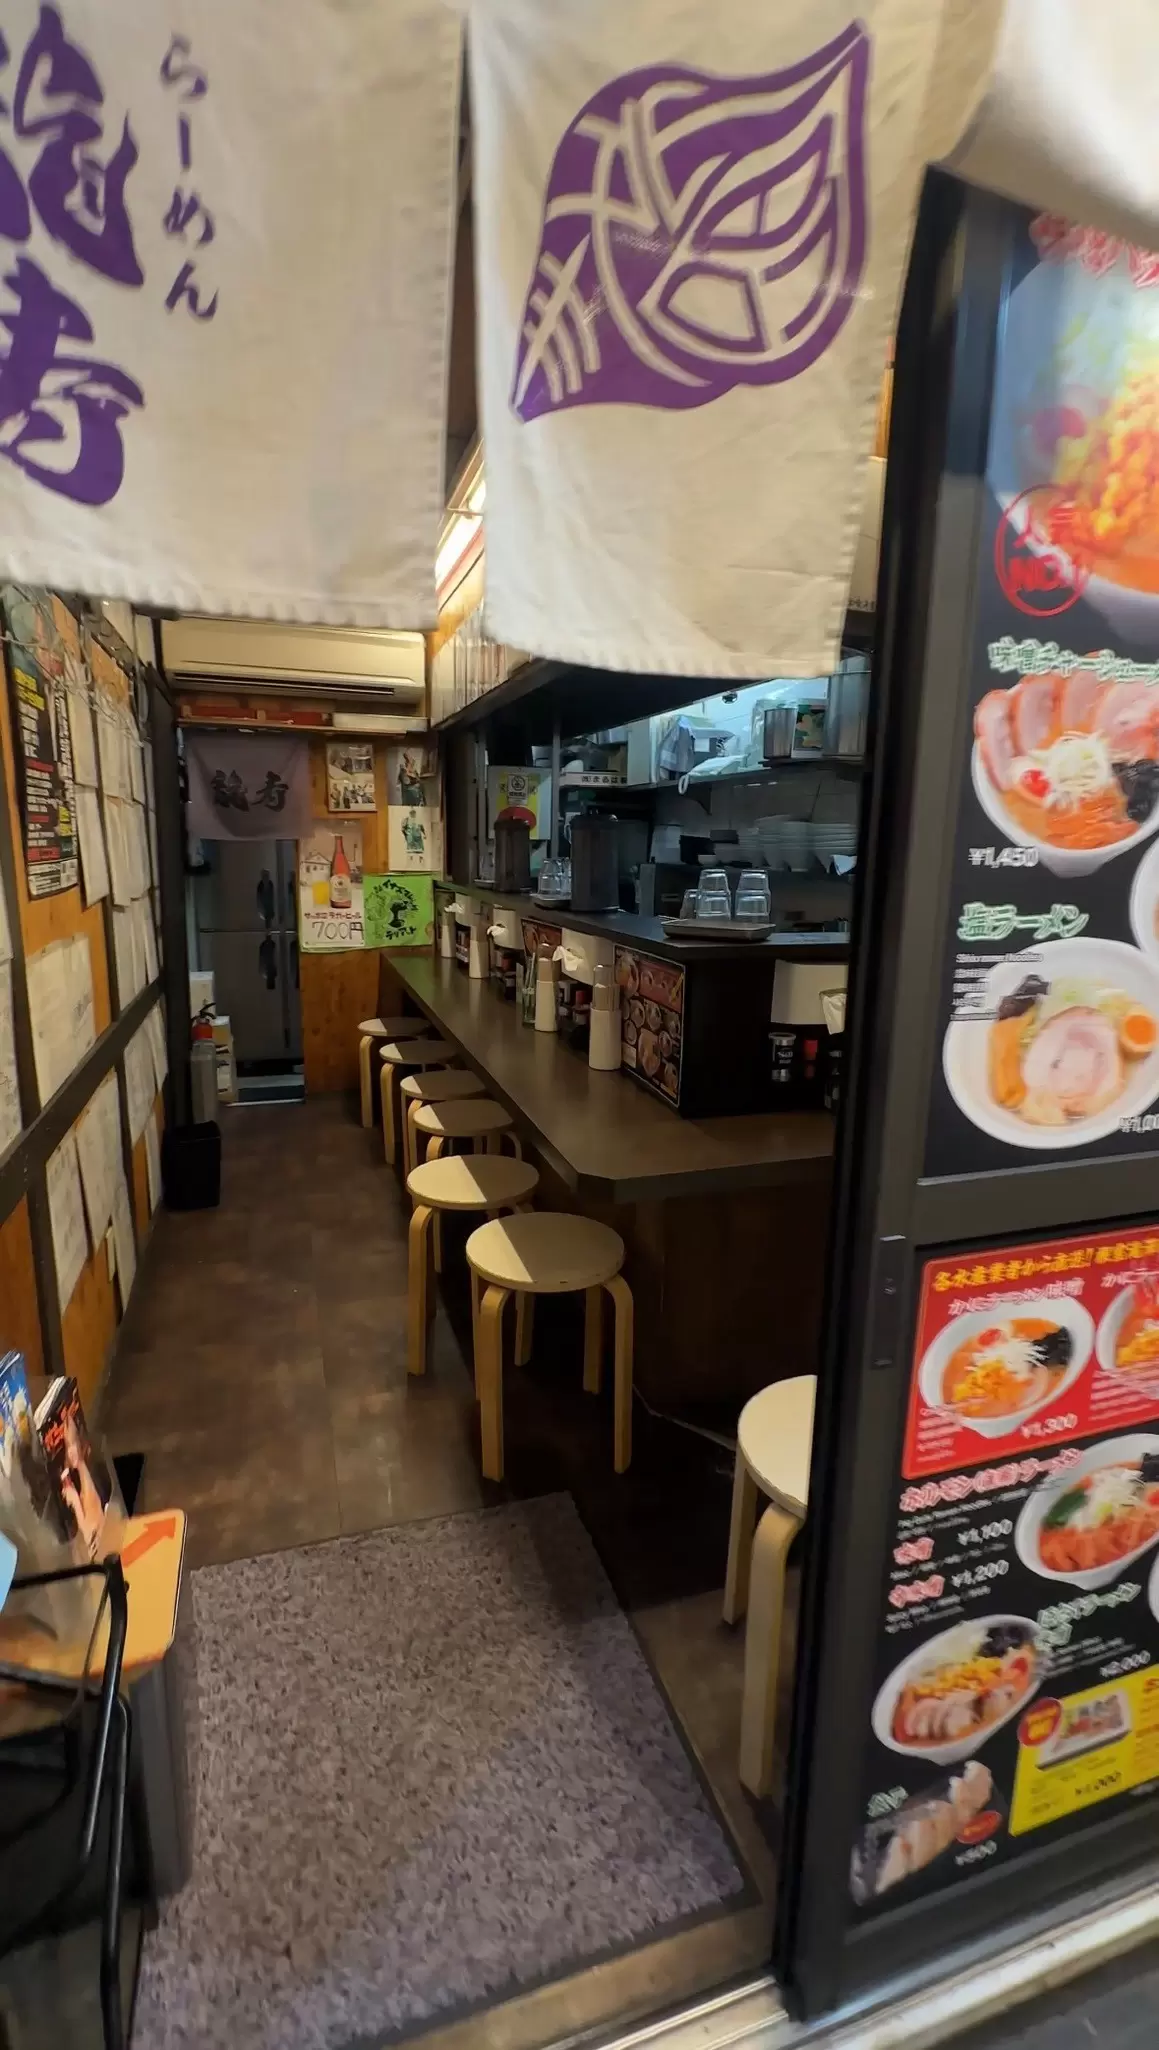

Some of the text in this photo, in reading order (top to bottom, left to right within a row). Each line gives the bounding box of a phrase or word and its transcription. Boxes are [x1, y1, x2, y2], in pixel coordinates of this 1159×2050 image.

[160, 32, 219, 321] らーめん
[968, 846, 1040, 868] ¥1,450
[312, 921, 364, 940] 700円
[956, 901, 1090, 941] 塩ラーメン
[1119, 1114, 1159, 1134] ¥1,0
[1019, 1413, 1078, 1439] ¥1,300
[957, 1518, 1013, 1546] ¥1,100
[951, 1559, 1010, 1587] ¥1,200
